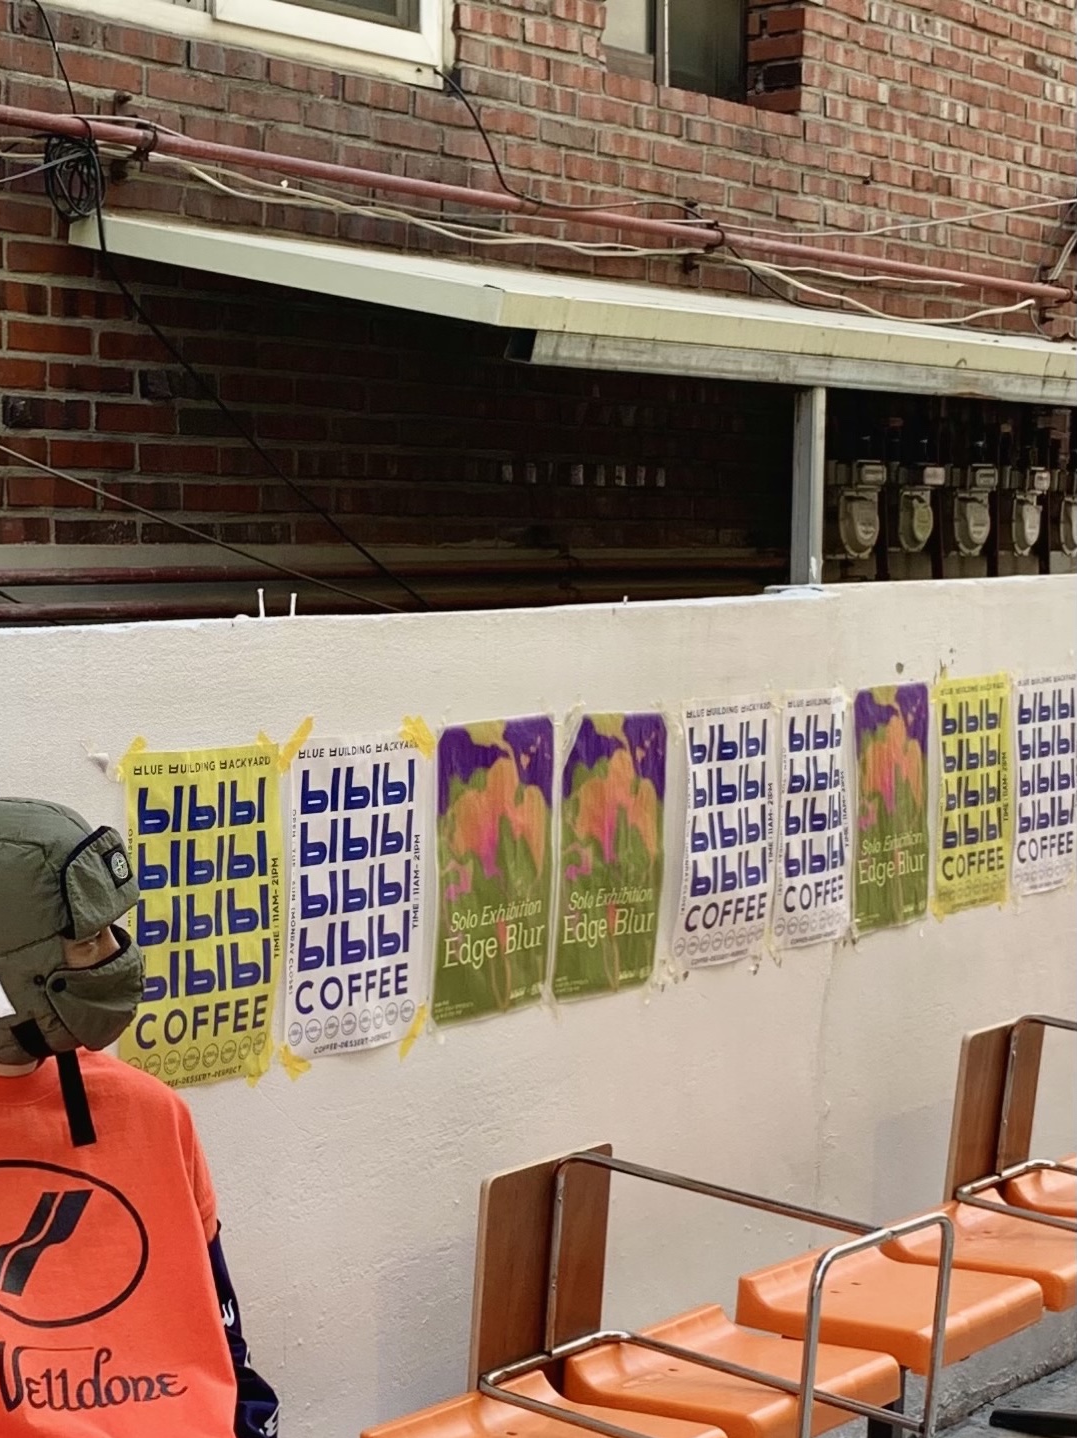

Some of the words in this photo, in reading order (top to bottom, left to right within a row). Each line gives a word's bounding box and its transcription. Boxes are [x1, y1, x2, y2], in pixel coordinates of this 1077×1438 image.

[942, 846, 1005, 881] COFFEE
[1017, 831, 1074, 865] COFFEE
[857, 859, 895, 887] Edge
[897, 851, 926, 877] Blur
[450, 911, 478, 933] Solo
[480, 898, 542, 926] Exhibition
[568, 891, 594, 911] Solo
[595, 886, 653, 907] Exhibition
[684, 892, 767, 933] COFFEE
[442, 936, 498, 970] Edge
[504, 923, 545, 955] Blur
[563, 914, 608, 948] Edge
[613, 907, 655, 937] Blur
[295, 963, 409, 1015] COFFEE
[135, 994, 269, 1050] COFFEE
